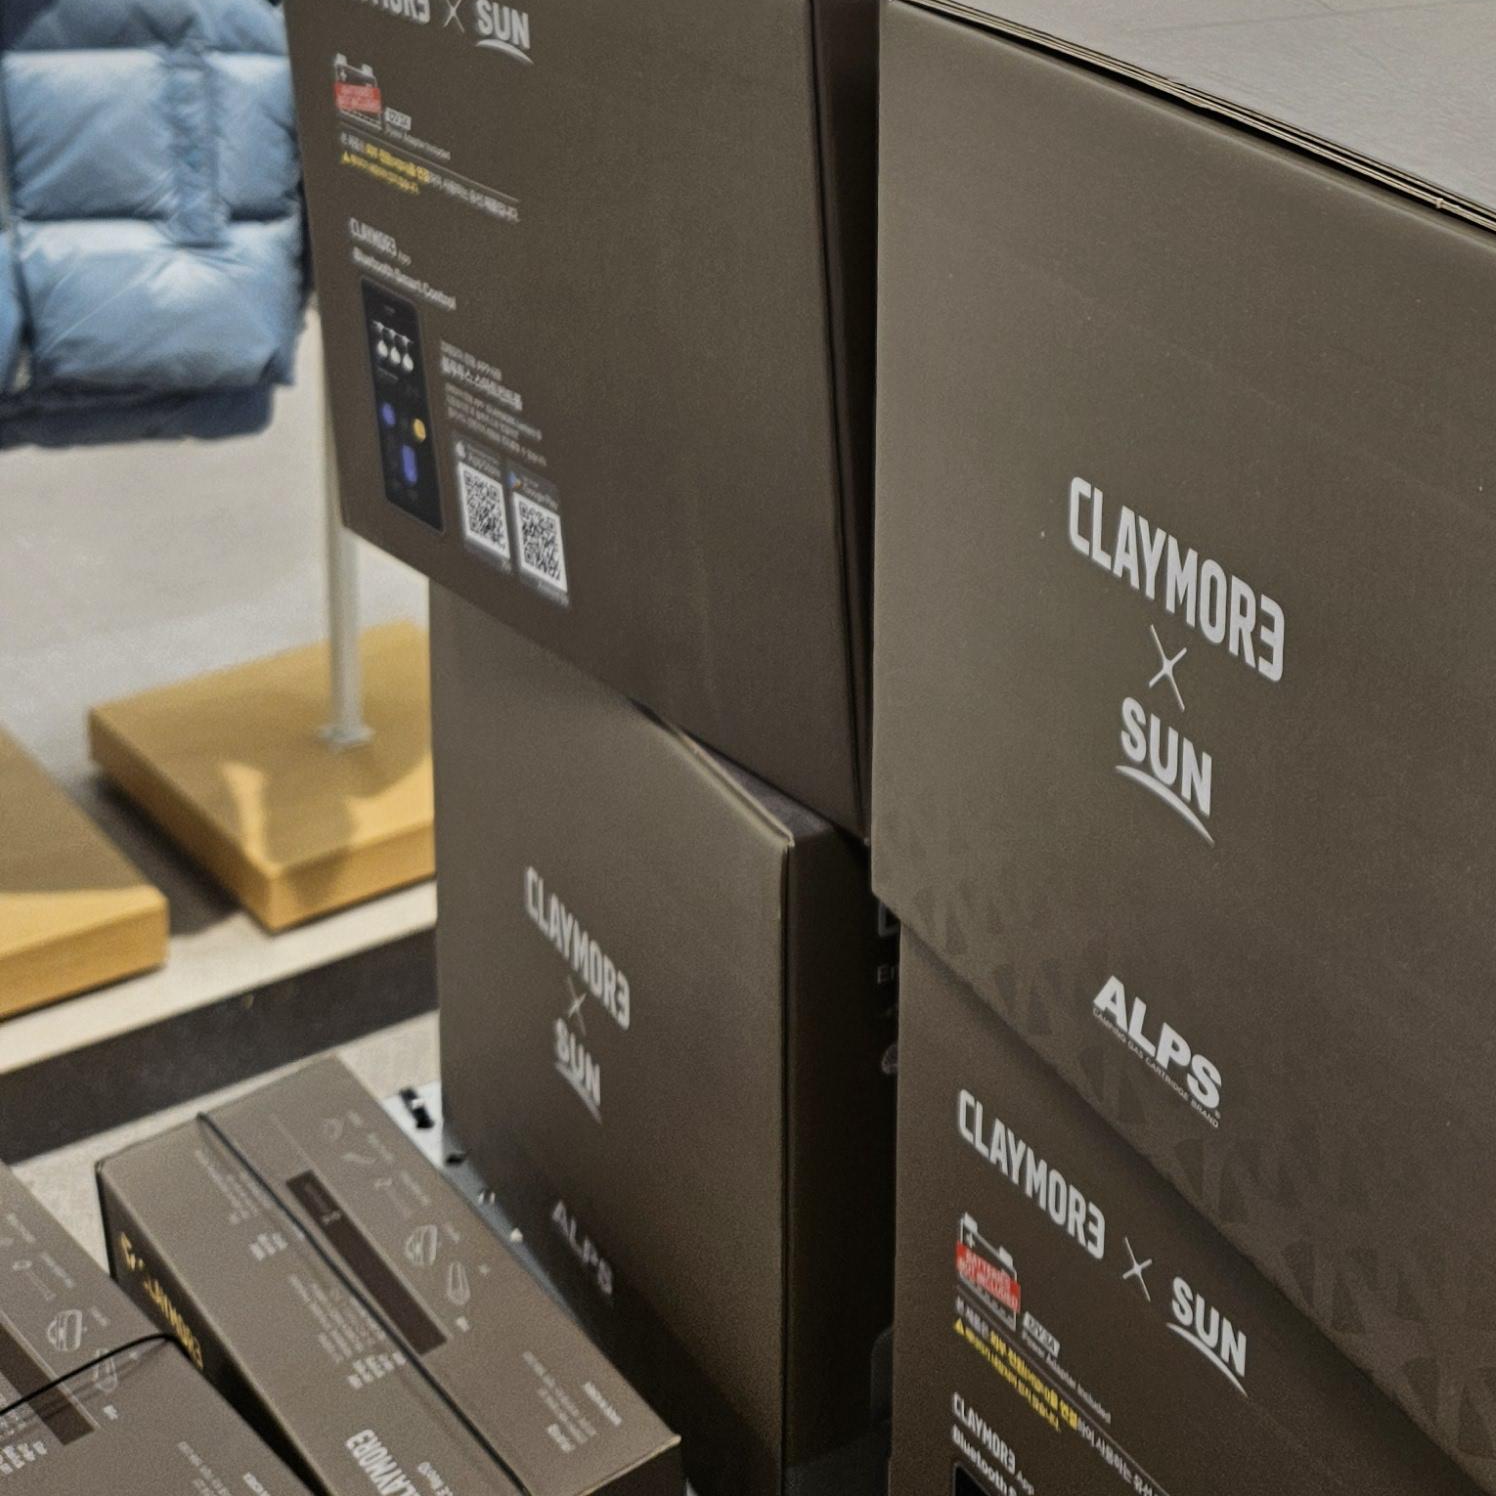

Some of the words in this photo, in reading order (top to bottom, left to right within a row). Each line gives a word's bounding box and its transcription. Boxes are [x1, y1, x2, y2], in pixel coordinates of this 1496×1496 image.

[1120, 696, 1213, 819] SUN
[1093, 975, 1222, 1109] ALPS
[1171, 1276, 1247, 1378] SUN
